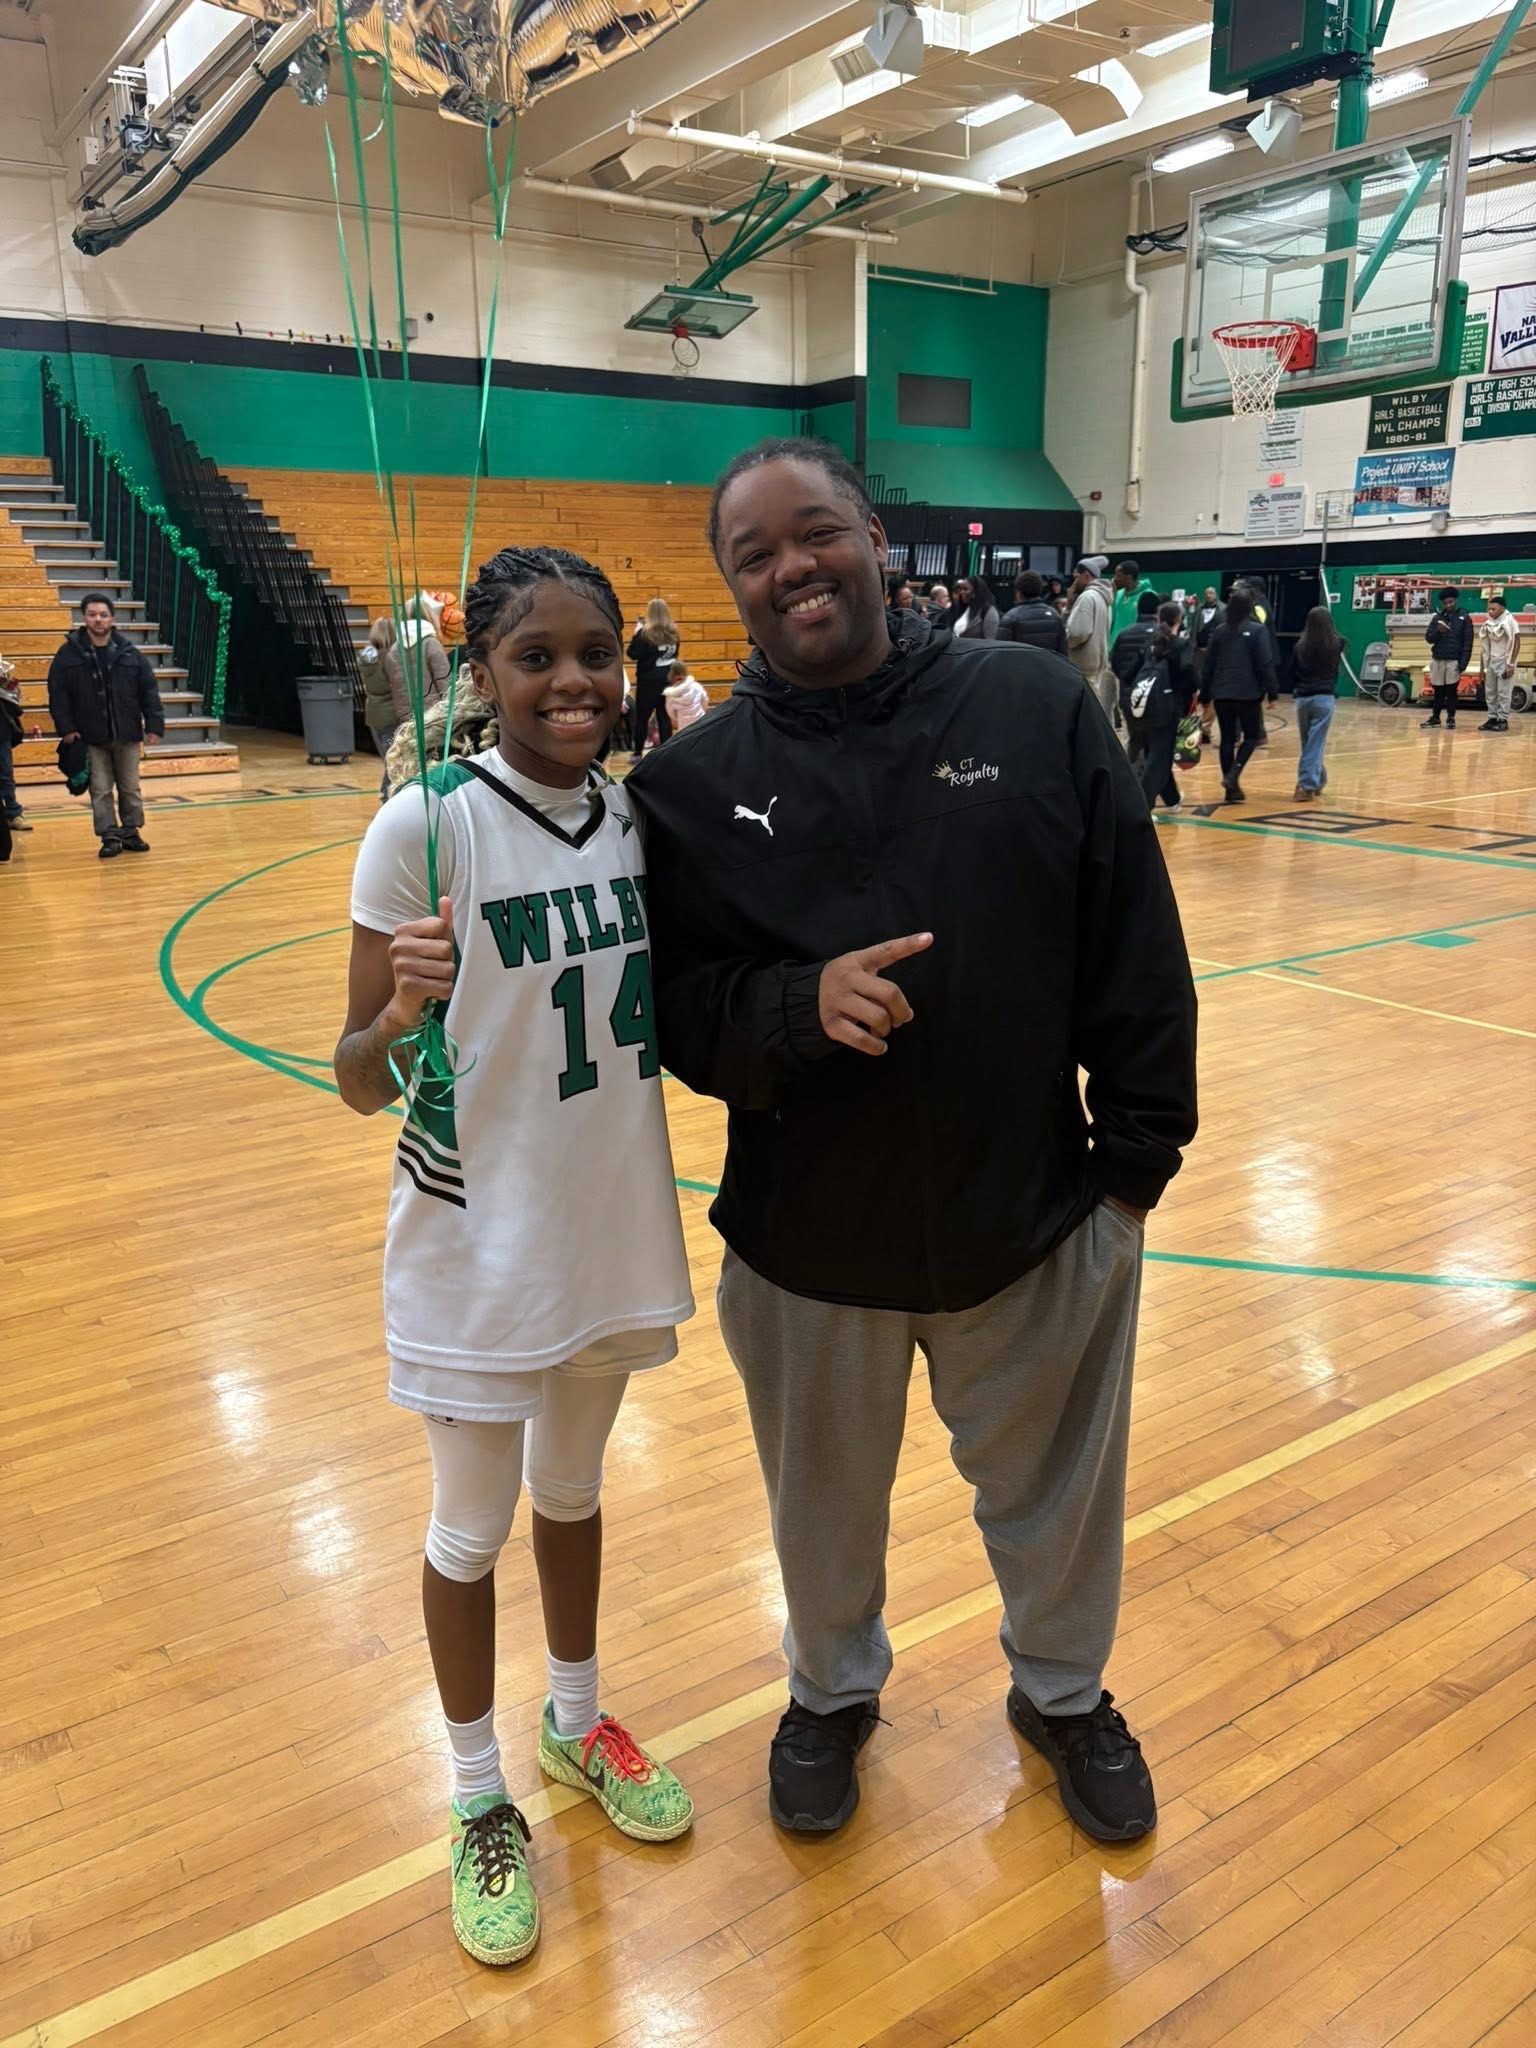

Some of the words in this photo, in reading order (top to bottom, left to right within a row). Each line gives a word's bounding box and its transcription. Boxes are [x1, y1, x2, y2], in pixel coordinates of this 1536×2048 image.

[1501, 325, 1536, 349] VALL
[1471, 381, 1496, 394] WILBY
[1498, 378, 1517, 390] HIGH
[1391, 393, 1428, 406] WILBY
[1470, 392, 1493, 405] GIRLS
[1374, 410, 1394, 420] GIRLS
[1397, 404, 1444, 419] BASKETBALL
[1473, 405, 1485, 416] NVL
[1487, 401, 1511, 414] DIVISION
[1374, 422, 1395, 434] NVL
[1397, 417, 1441, 431] CHAMPS
[1385, 432, 1427, 444] 1980-81
[1361, 465, 1391, 479] Project
[1391, 460, 1420, 475] UNIFY
[1418, 458, 1449, 473] School
[625, 557, 633, 569] 2
[960, 757, 975, 770] CT
[950, 763, 999, 787] Royalty
[551, 949, 661, 1102] 14
